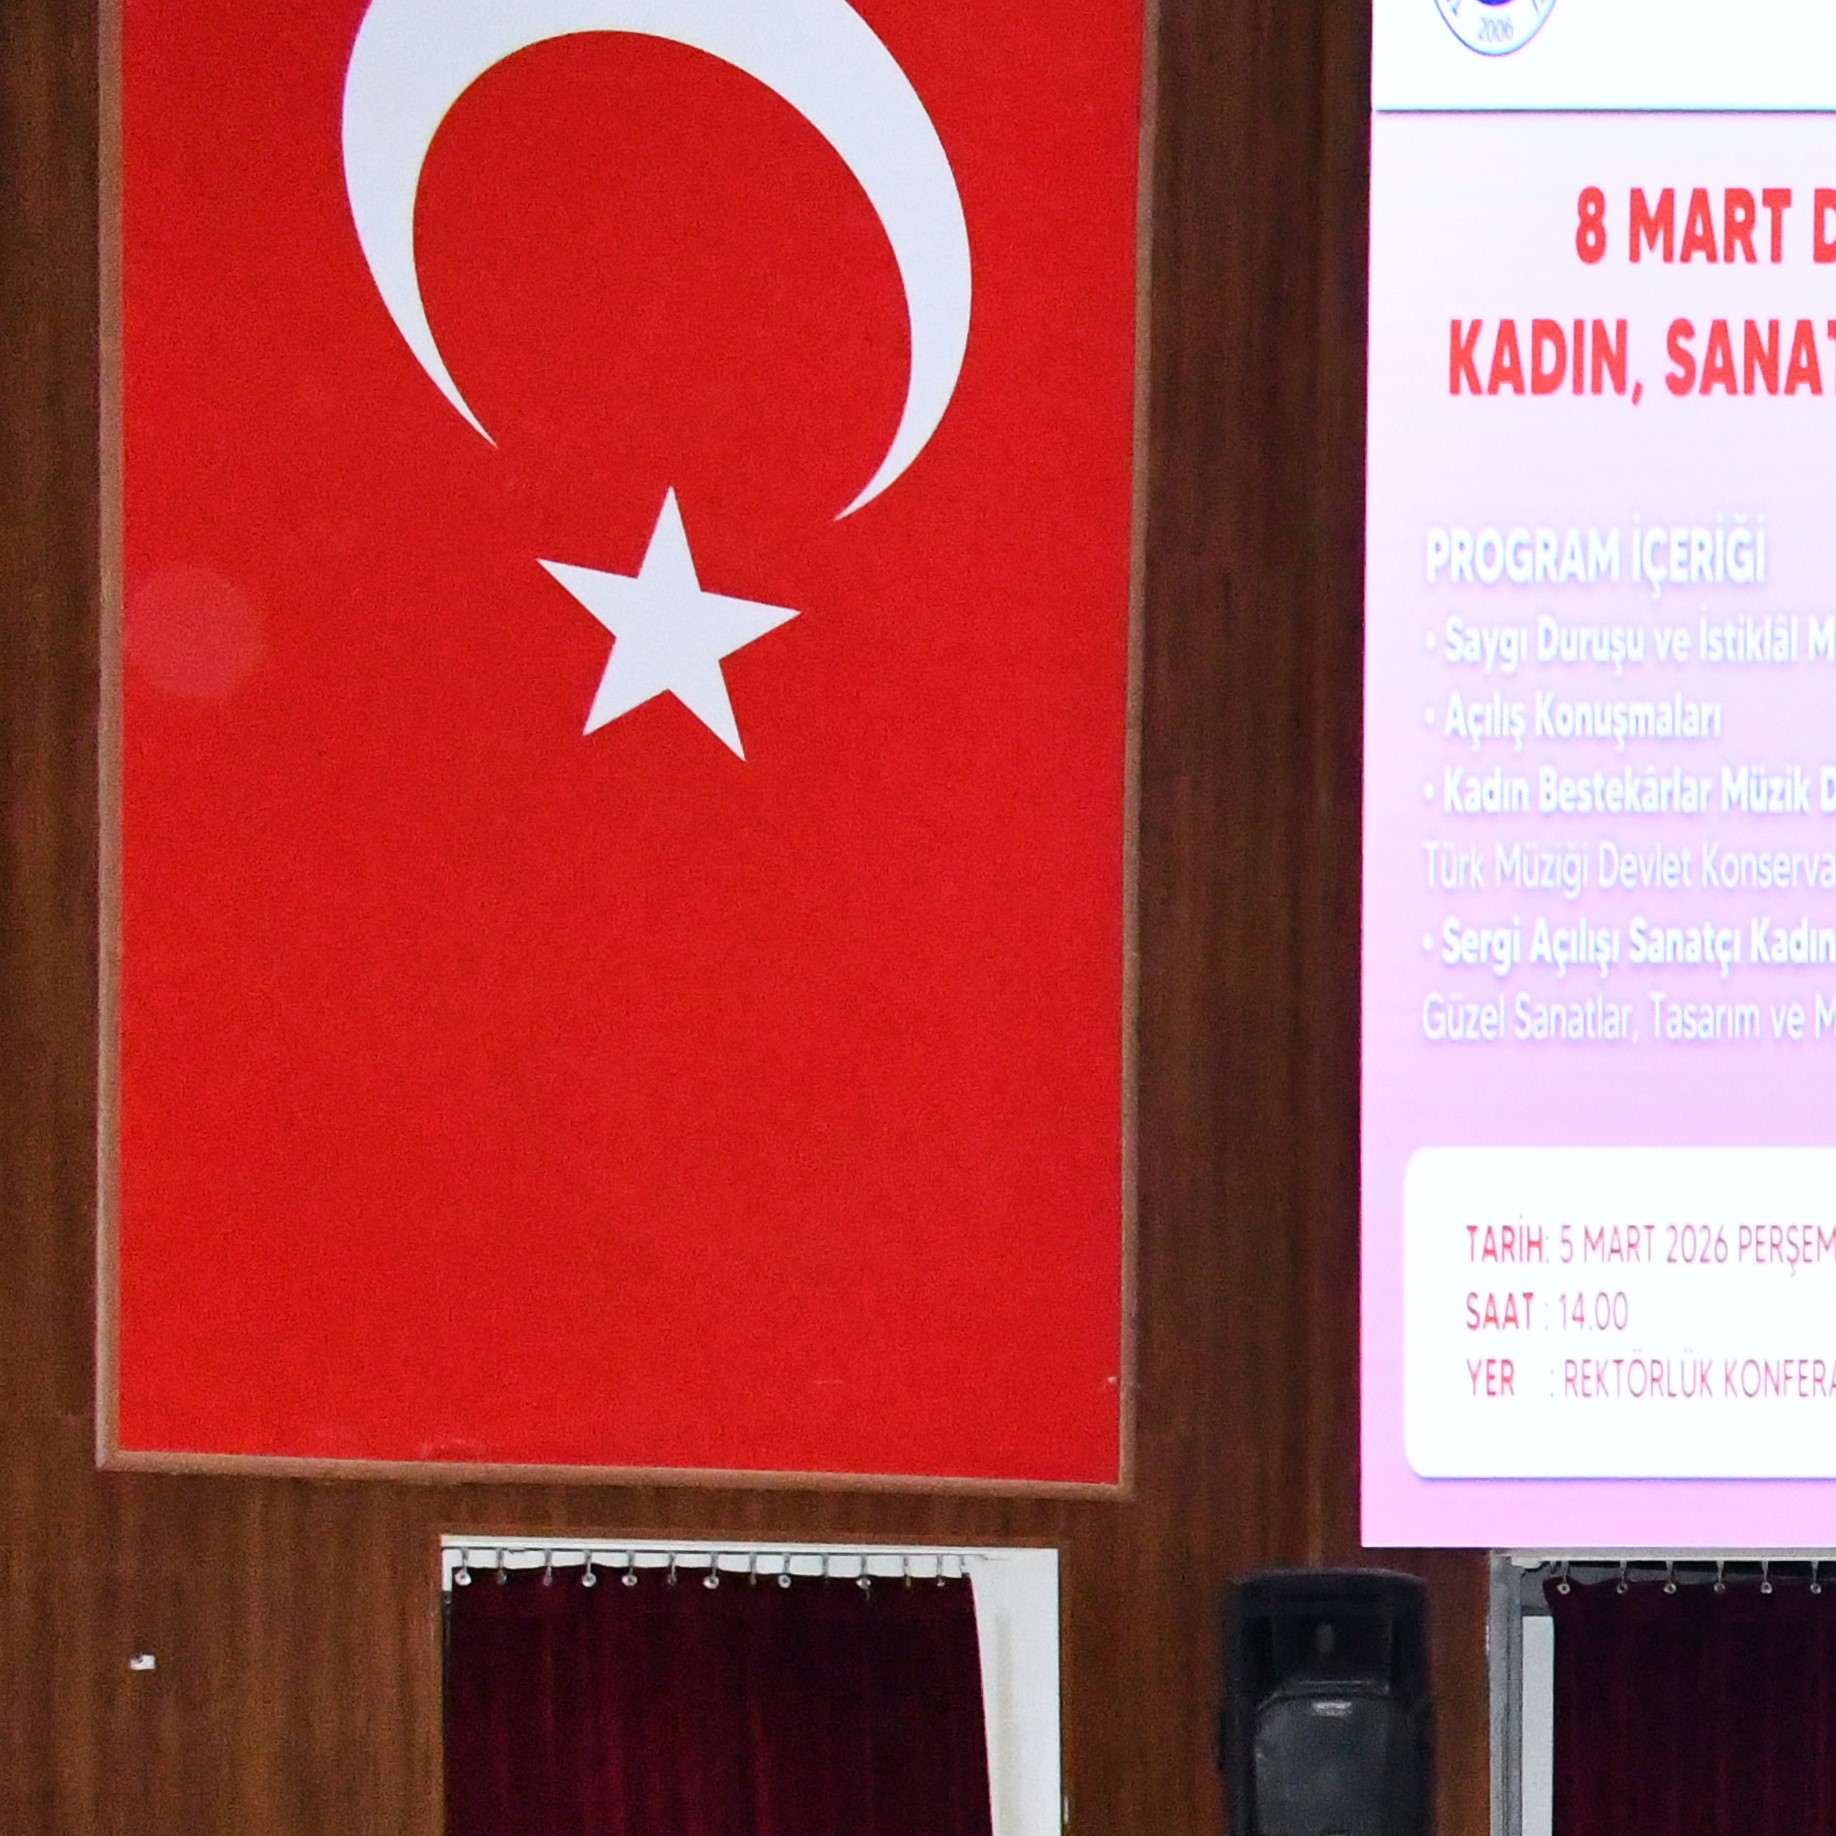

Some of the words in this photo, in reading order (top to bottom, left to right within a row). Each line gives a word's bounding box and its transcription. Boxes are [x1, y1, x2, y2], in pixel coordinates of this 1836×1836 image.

[1576, 186, 1607, 265] 8
[1629, 187, 1792, 264] MART
[1449, 319, 1643, 406] KADIN,
[1427, 527, 1620, 582] PROGRAM
[1632, 511, 1765, 599] İÇERİĞİ
[1445, 615, 1528, 673] Saygı
[1538, 615, 1645, 676] Duruşu
[1654, 628, 1690, 661] ve
[1700, 603, 1798, 661] İstiklâl
[1445, 691, 1526, 751] Açılış
[1535, 691, 1721, 750] Konuşmaları
[1445, 766, 1529, 812] Kadın
[1539, 765, 1712, 812] Bestekârlar
[1722, 765, 1810, 811] Müzik
[1423, 841, 1484, 887] Türk
[1495, 841, 1588, 899] Müziği
[1599, 840, 1691, 887] Devlet
[1443, 915, 1520, 975] Sergi
[1530, 917, 1619, 977] Açılışı
[1629, 916, 1741, 977] Sanatçı
[1751, 917, 1836, 962] Kadın
[1423, 992, 1505, 1039] Güzel
[1515, 992, 1639, 1043] Sanatlar,
[1649, 992, 1760, 1038] Tasarım
[1770, 1004, 1805, 1038] ve
[1561, 1225, 1572, 1263] 5
[1585, 1225, 1655, 1261] MART
[1667, 1225, 1728, 1264] 2026
[1467, 1292, 1534, 1331] SAAT
[1561, 1292, 1627, 1330] 14.00
[1467, 1359, 1514, 1397] YER
[1565, 1348, 1712, 1398] REKTÖRLÜK
